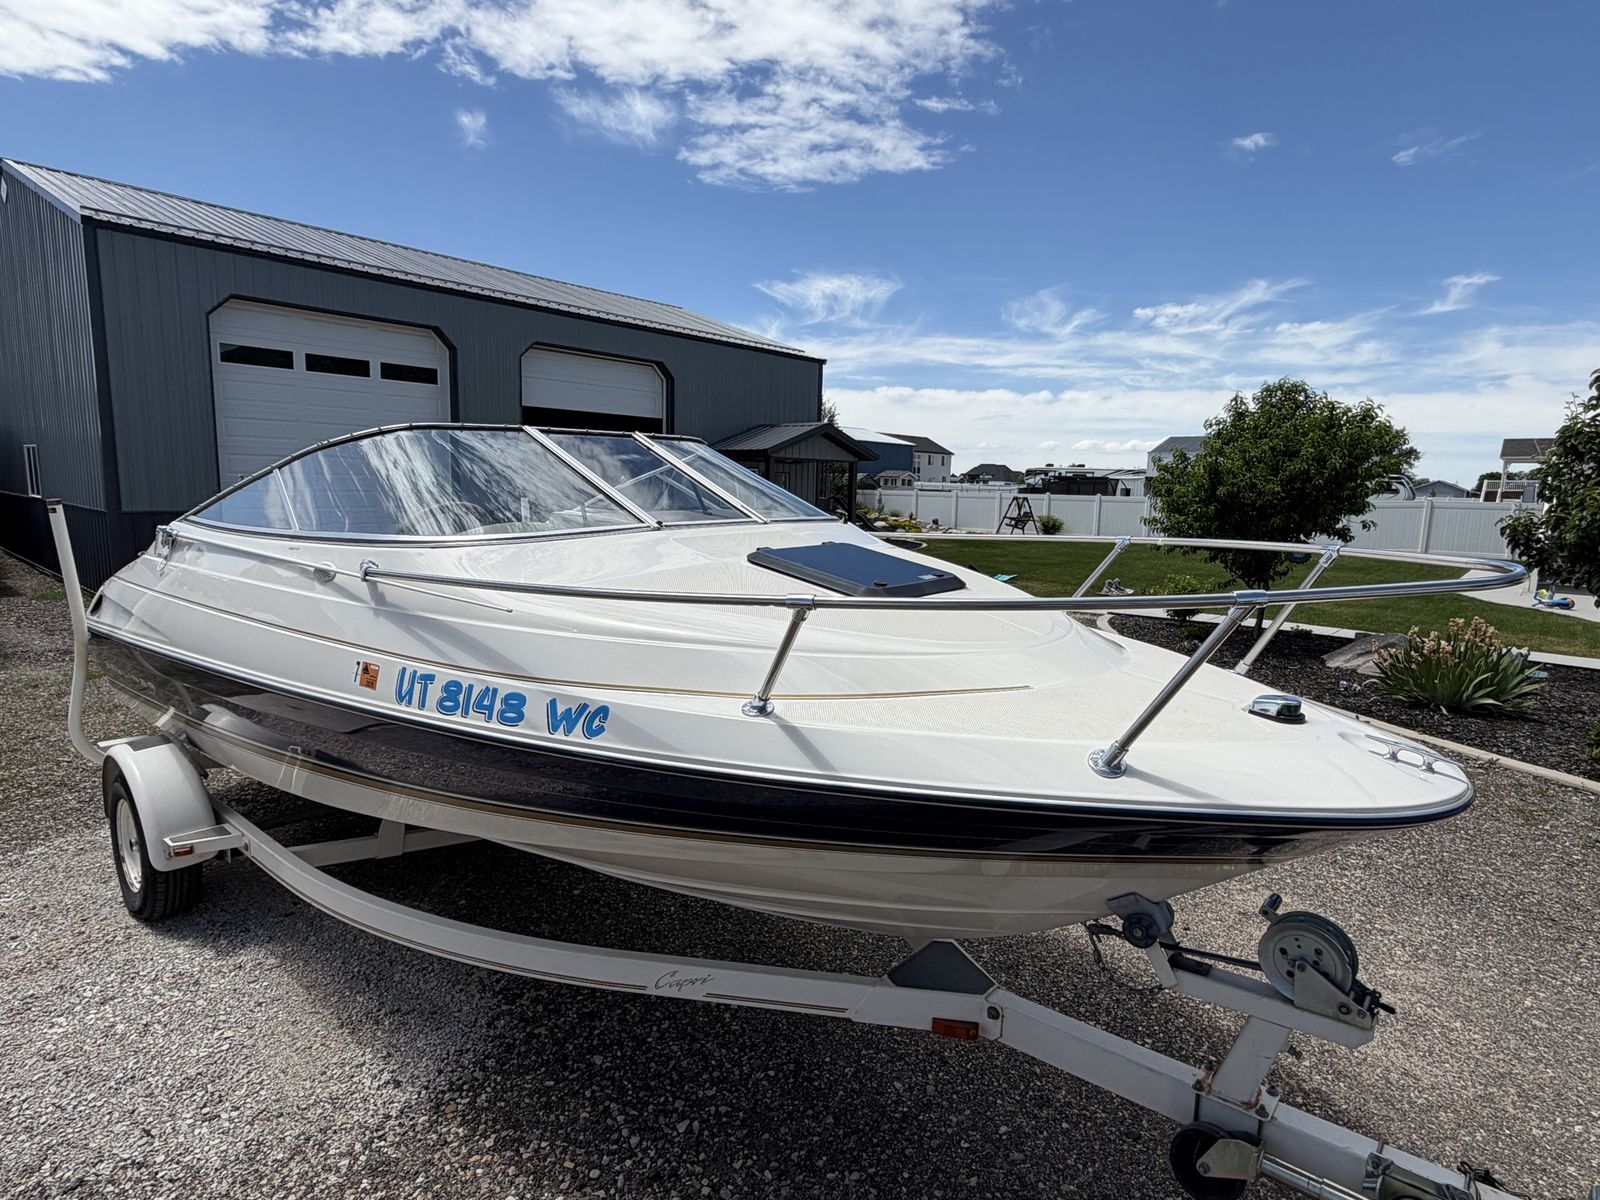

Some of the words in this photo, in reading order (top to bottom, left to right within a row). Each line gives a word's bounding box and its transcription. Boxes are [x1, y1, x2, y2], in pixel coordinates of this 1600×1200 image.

[395, 666, 436, 710] UT
[436, 679, 527, 726] 8148
[547, 697, 610, 740] WC
[654, 969, 715, 992] Capri
